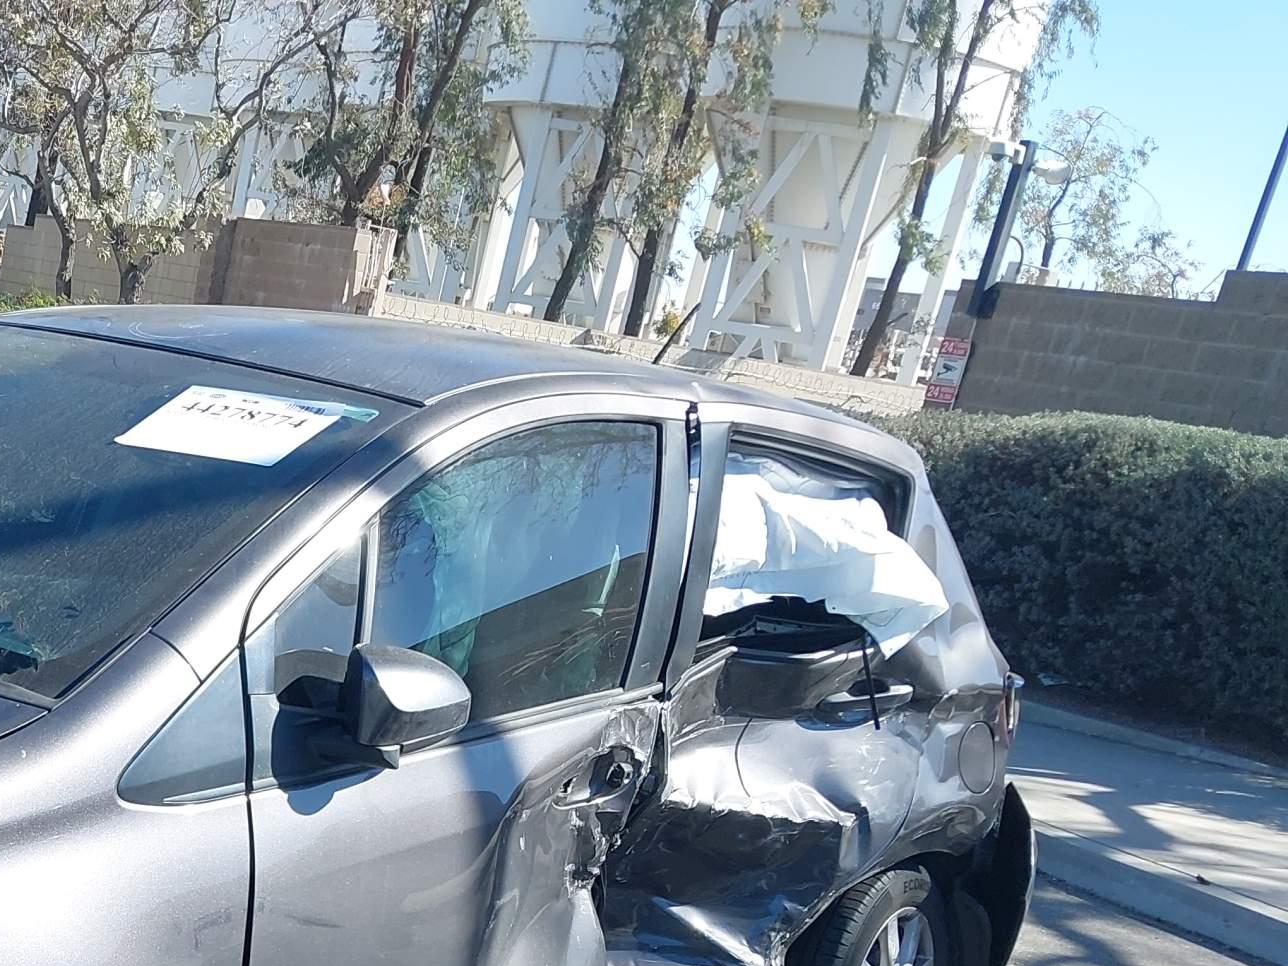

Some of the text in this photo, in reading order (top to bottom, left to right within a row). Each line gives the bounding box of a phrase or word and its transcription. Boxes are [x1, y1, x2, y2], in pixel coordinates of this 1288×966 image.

[941, 340, 955, 353] 24
[927, 385, 941, 398] 24
[182, 401, 309, 428] 44278774
